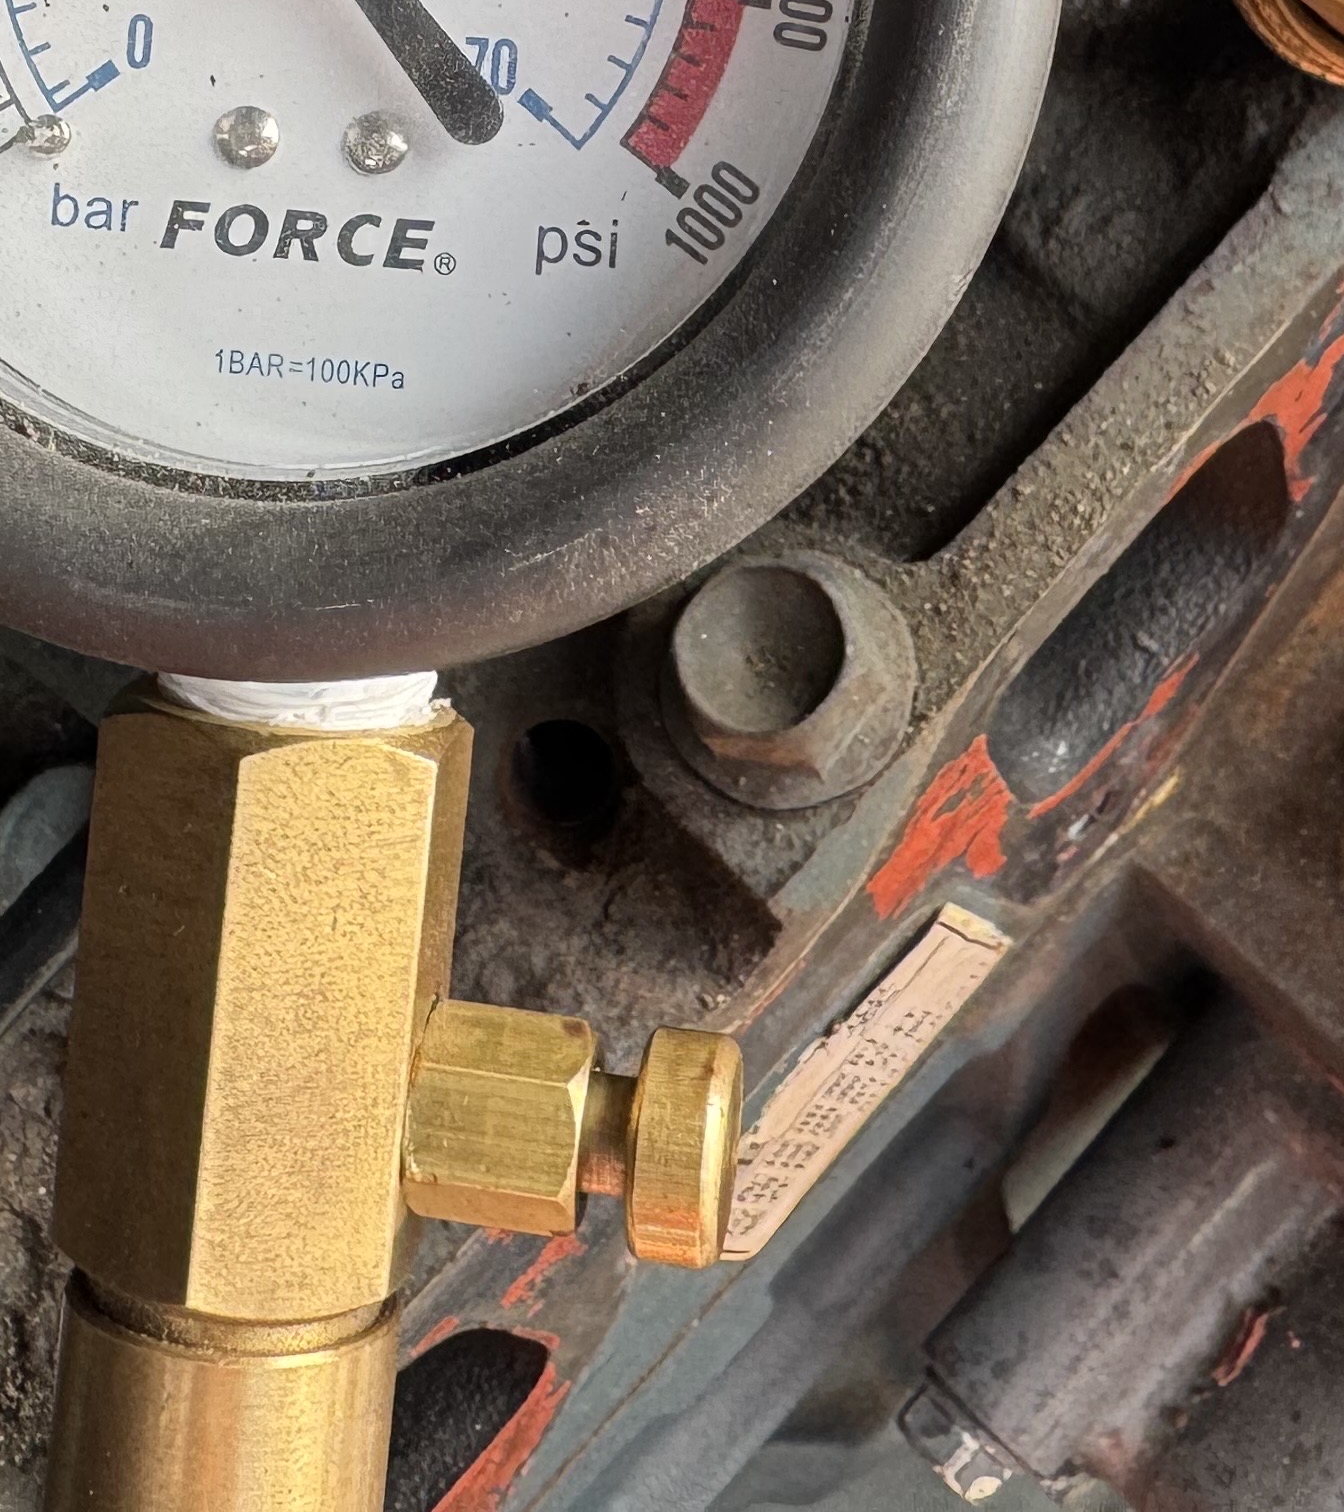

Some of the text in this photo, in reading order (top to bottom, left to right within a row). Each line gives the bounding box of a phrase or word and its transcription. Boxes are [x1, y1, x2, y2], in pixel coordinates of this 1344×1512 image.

[126, 13, 154, 69] 0
[464, 36, 518, 96] 70
[50, 182, 139, 233] bar
[664, 160, 761, 266] 1000
[535, 218, 619, 275] psi
[214, 348, 406, 390] 1BAR=100KPa
